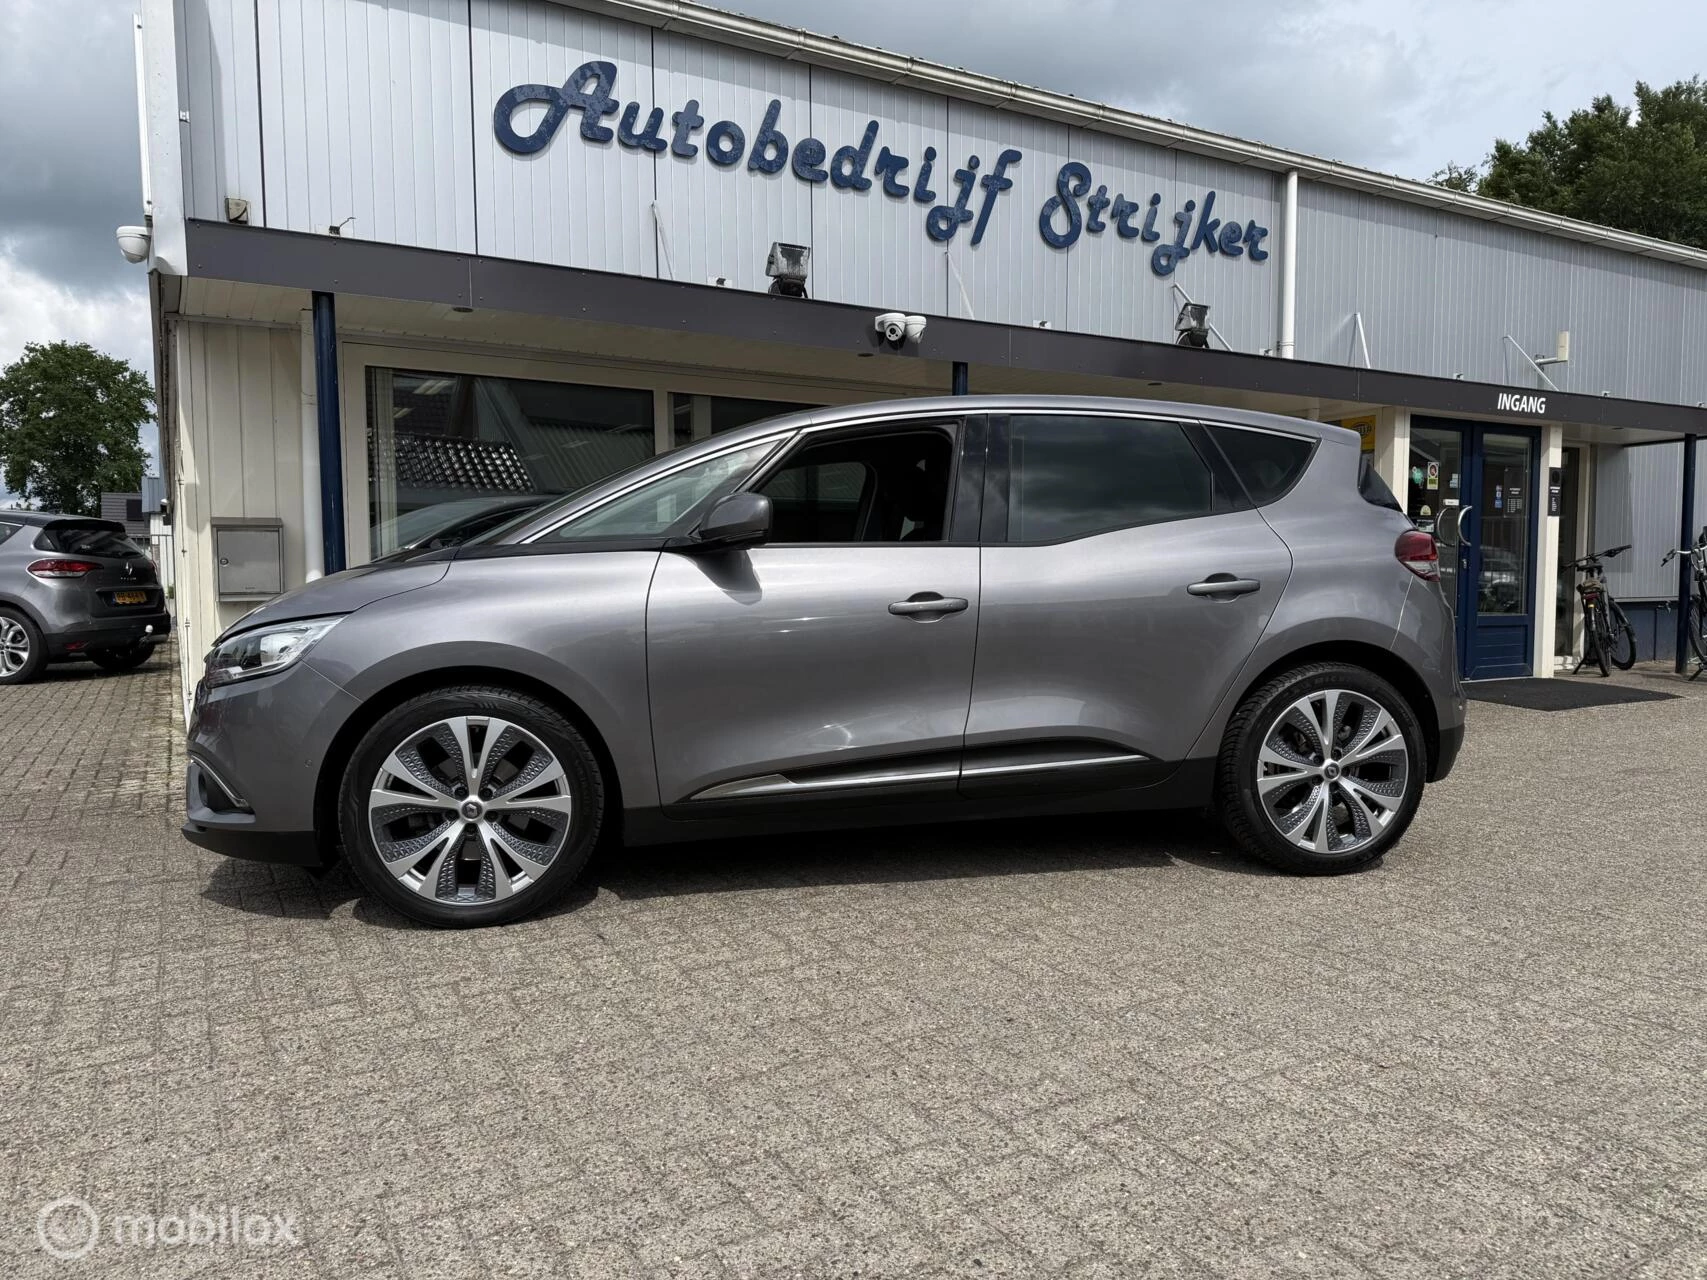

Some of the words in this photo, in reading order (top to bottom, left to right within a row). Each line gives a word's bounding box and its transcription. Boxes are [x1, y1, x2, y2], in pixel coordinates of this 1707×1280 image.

[493, 60, 1023, 246] Autobedrijf
[1038, 161, 1270, 277] Strijker
[1497, 392, 1546, 414] INGANG
